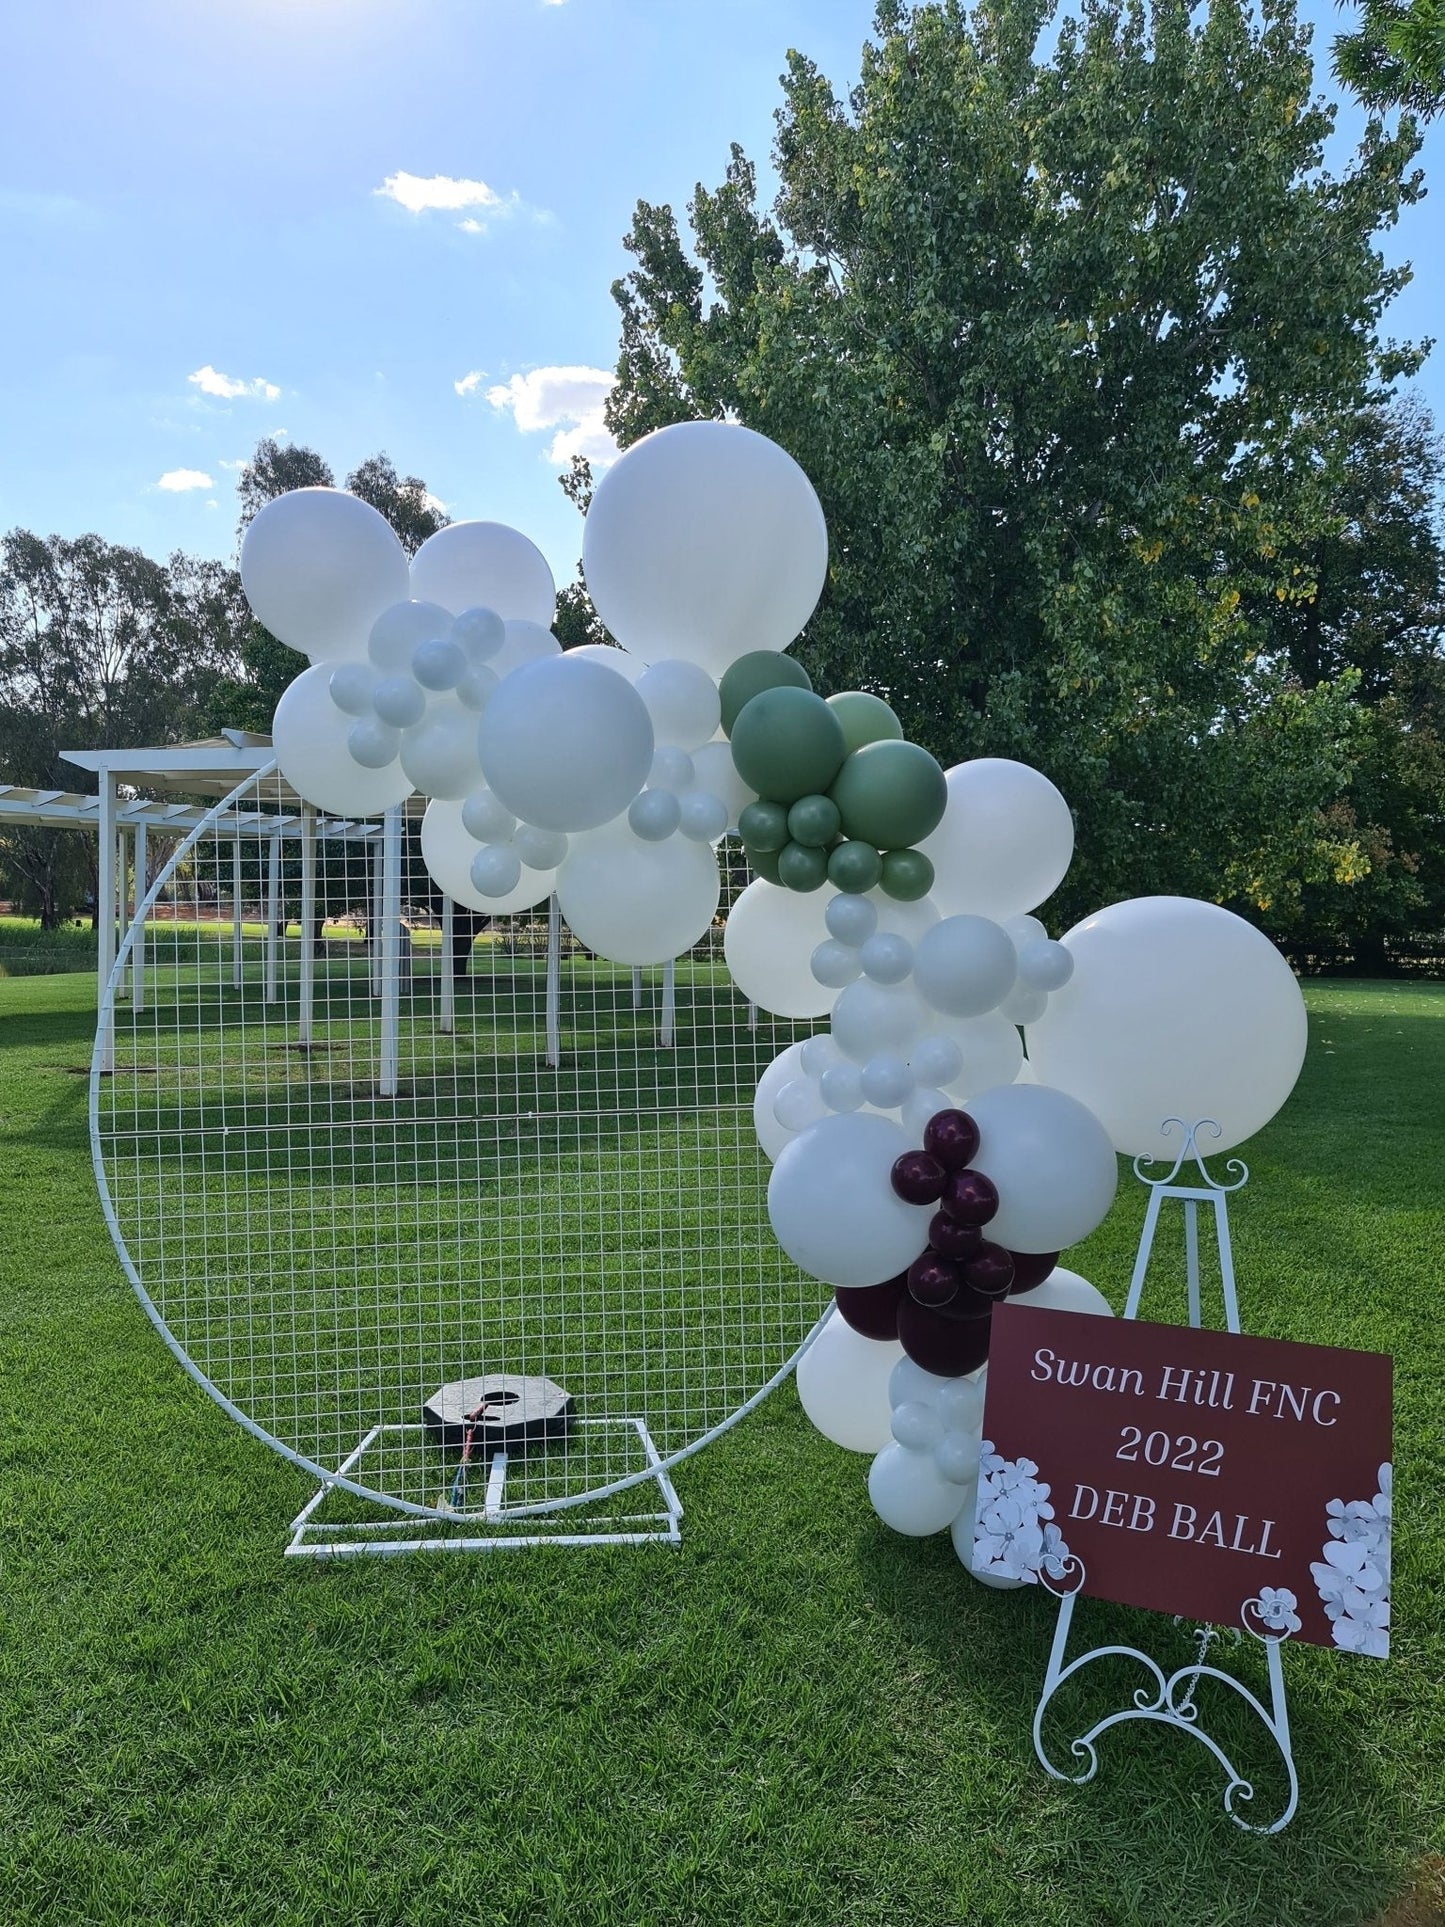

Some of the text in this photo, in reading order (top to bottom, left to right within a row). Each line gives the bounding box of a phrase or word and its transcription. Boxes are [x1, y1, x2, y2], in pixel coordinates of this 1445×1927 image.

[1030, 1348, 1341, 1426] Swan Hill FNC
[1116, 1426, 1225, 1476] 2022
[1068, 1484, 1282, 1559] DEB BALL
